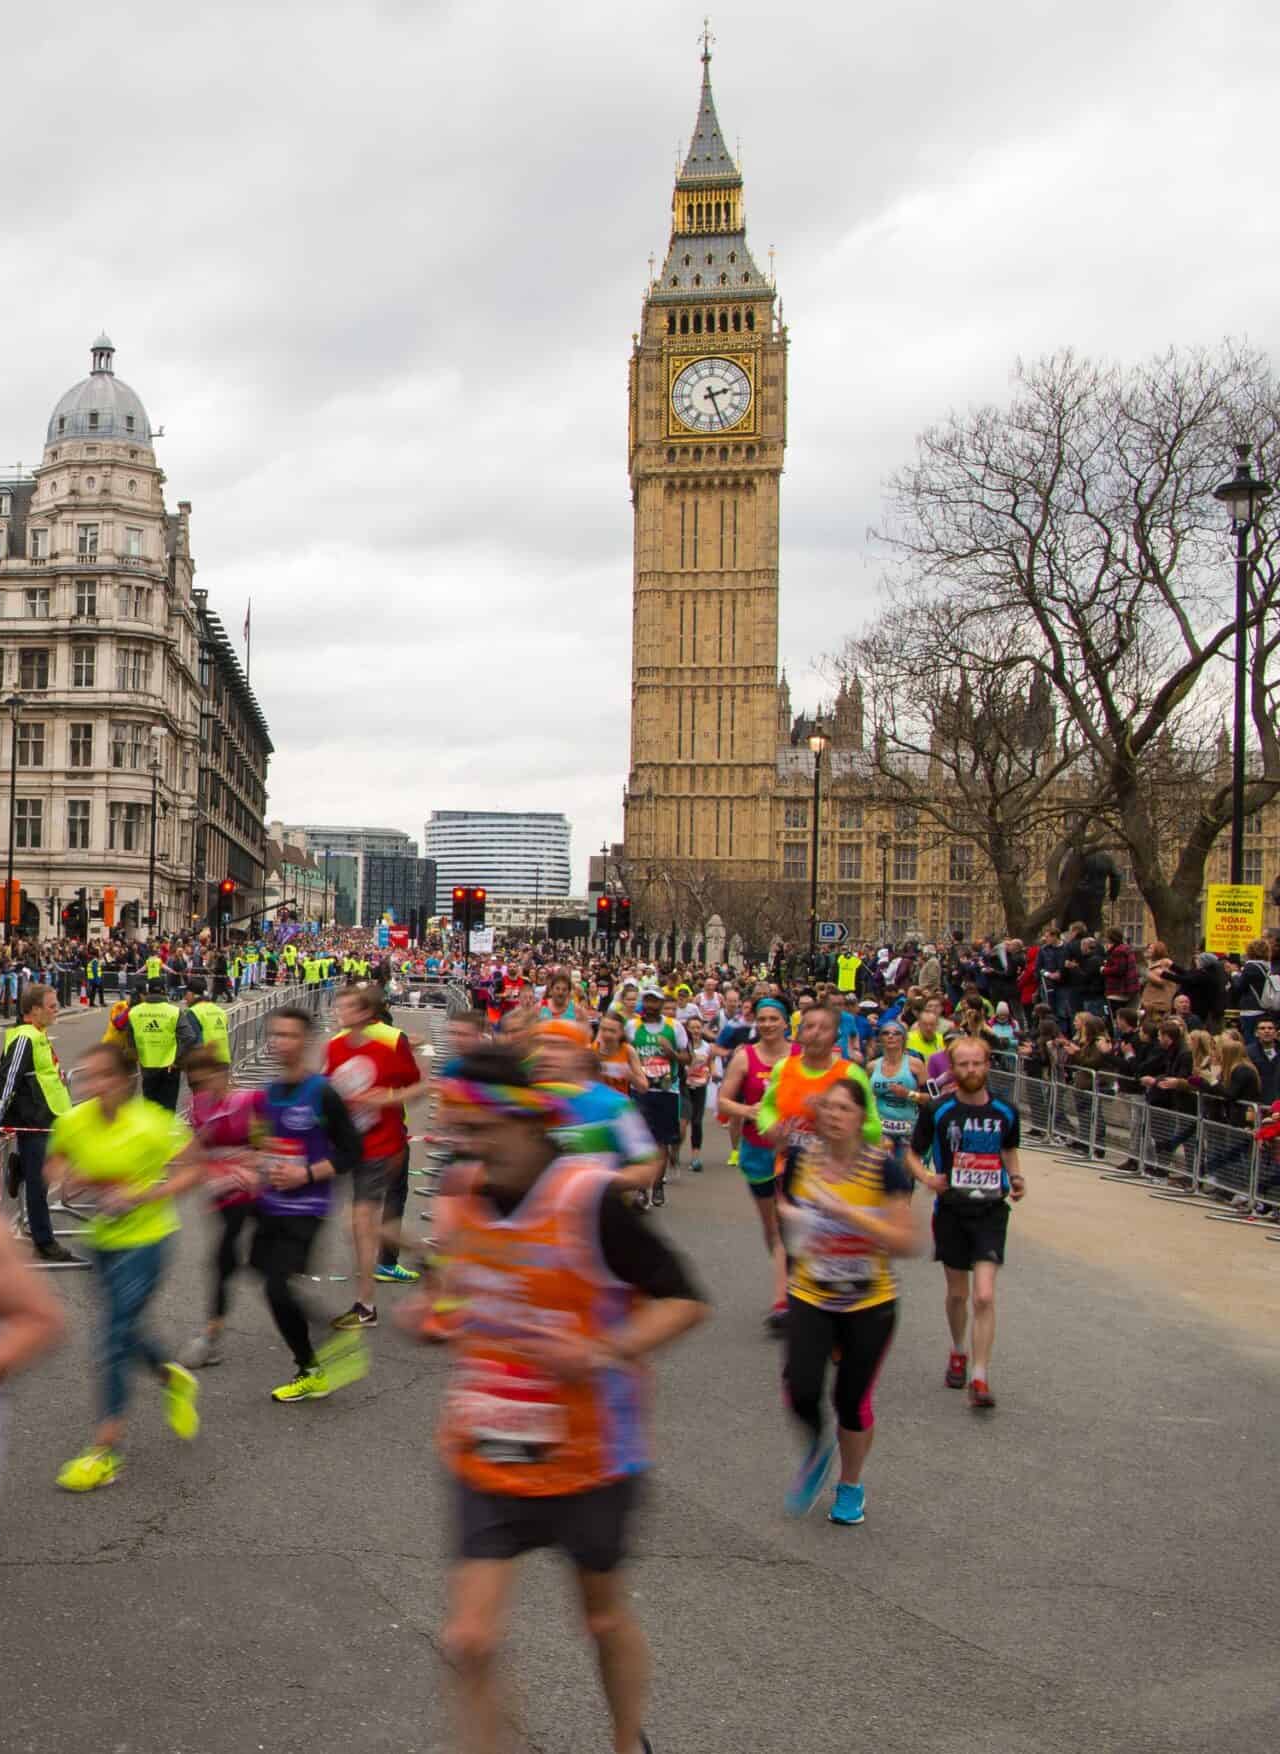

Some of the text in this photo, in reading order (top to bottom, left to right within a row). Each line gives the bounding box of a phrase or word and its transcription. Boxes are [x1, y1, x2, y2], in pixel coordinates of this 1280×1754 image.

[824, 925, 832, 937] P
[1216, 924, 1252, 932] CLOSED
[963, 1117, 1001, 1133] ALEX
